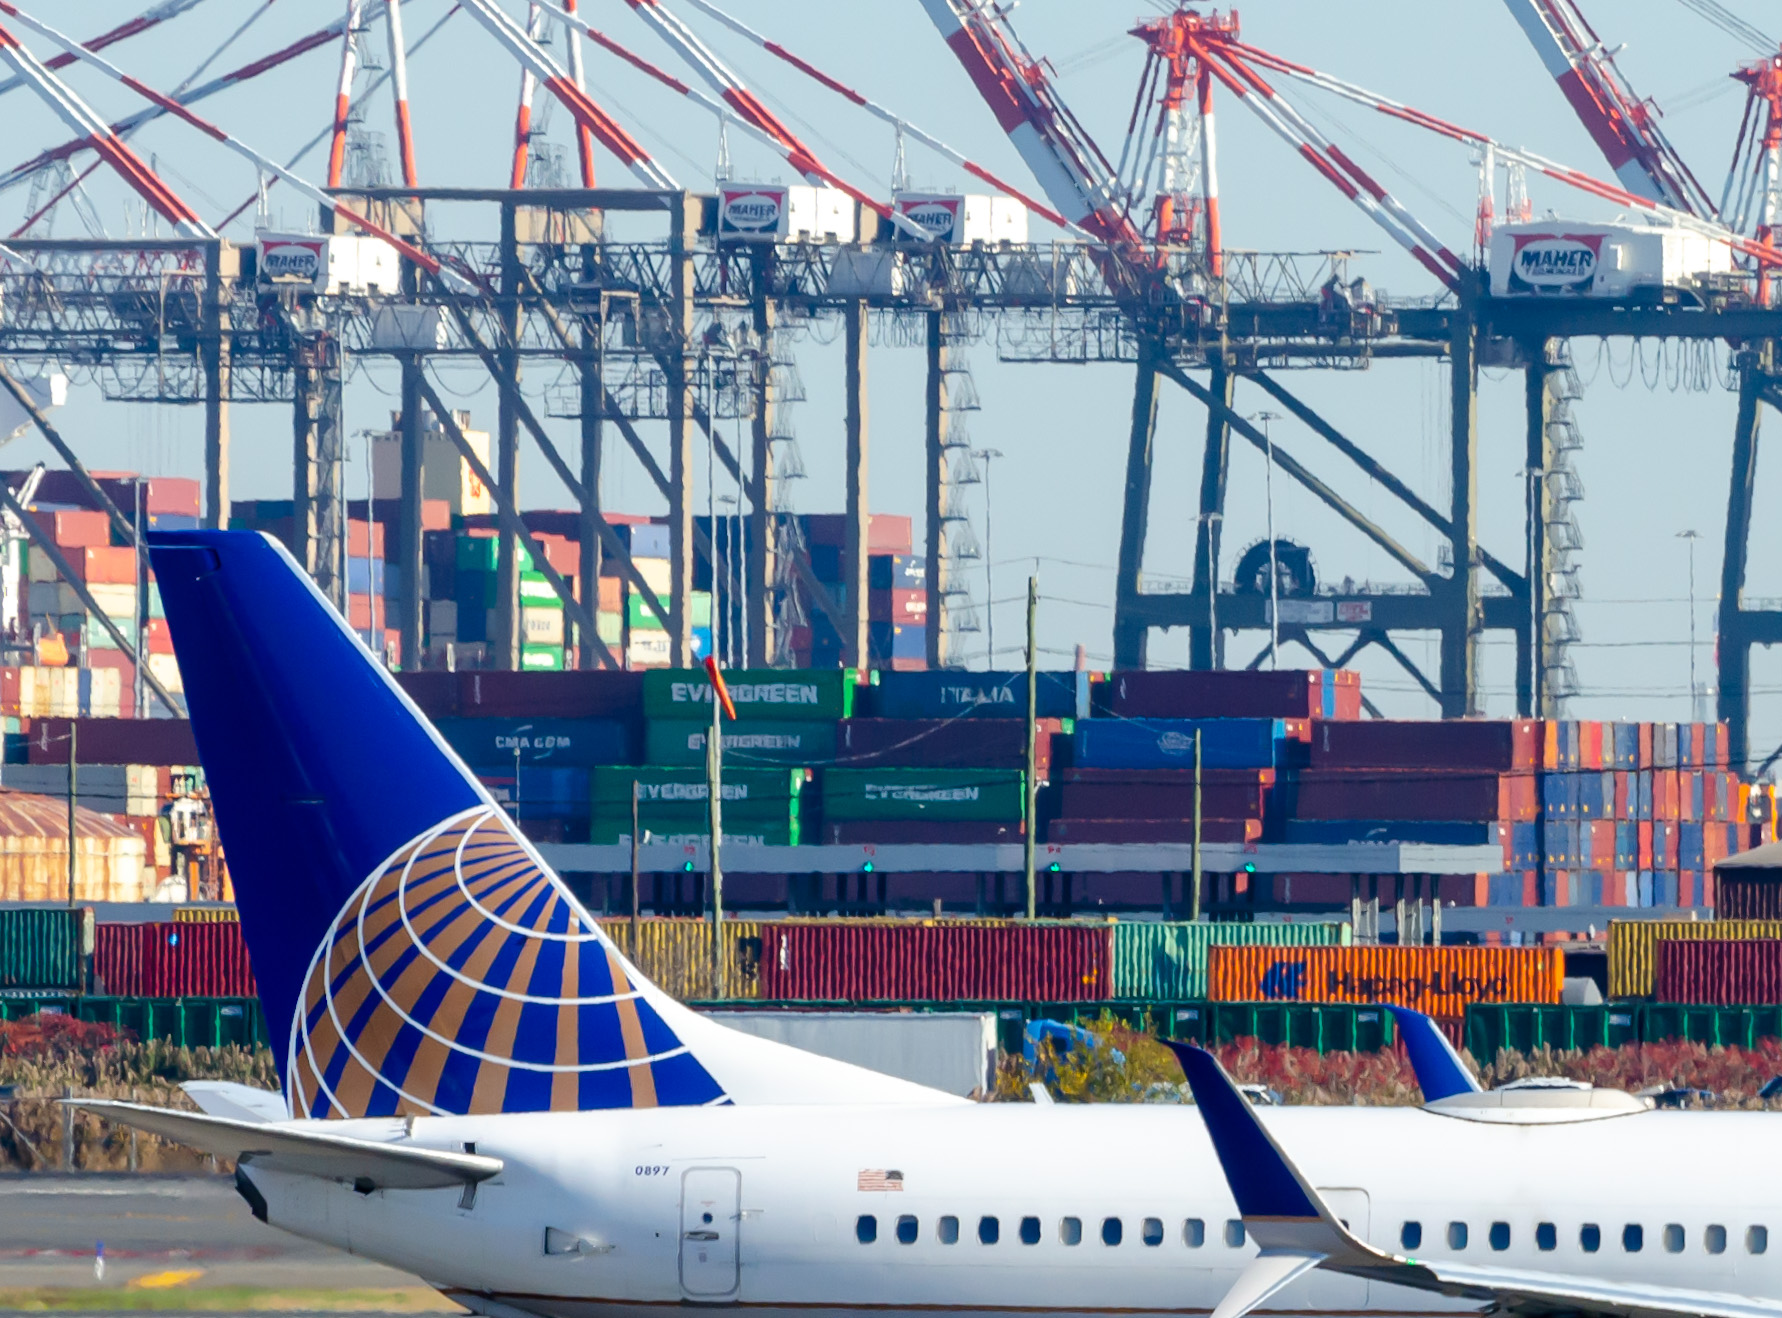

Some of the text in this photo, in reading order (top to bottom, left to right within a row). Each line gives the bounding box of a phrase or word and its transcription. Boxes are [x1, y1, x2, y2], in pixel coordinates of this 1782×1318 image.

[727, 204, 777, 216] MAHER
[265, 254, 316, 268] MAHER
[1520, 250, 1594, 268] MAHER
[495, 735, 530, 748] CMA
[636, 782, 748, 800] EVERGREN
[1329, 970, 1508, 1001] Hapag-Lloyd
[635, 1164, 670, 1177] 0897
